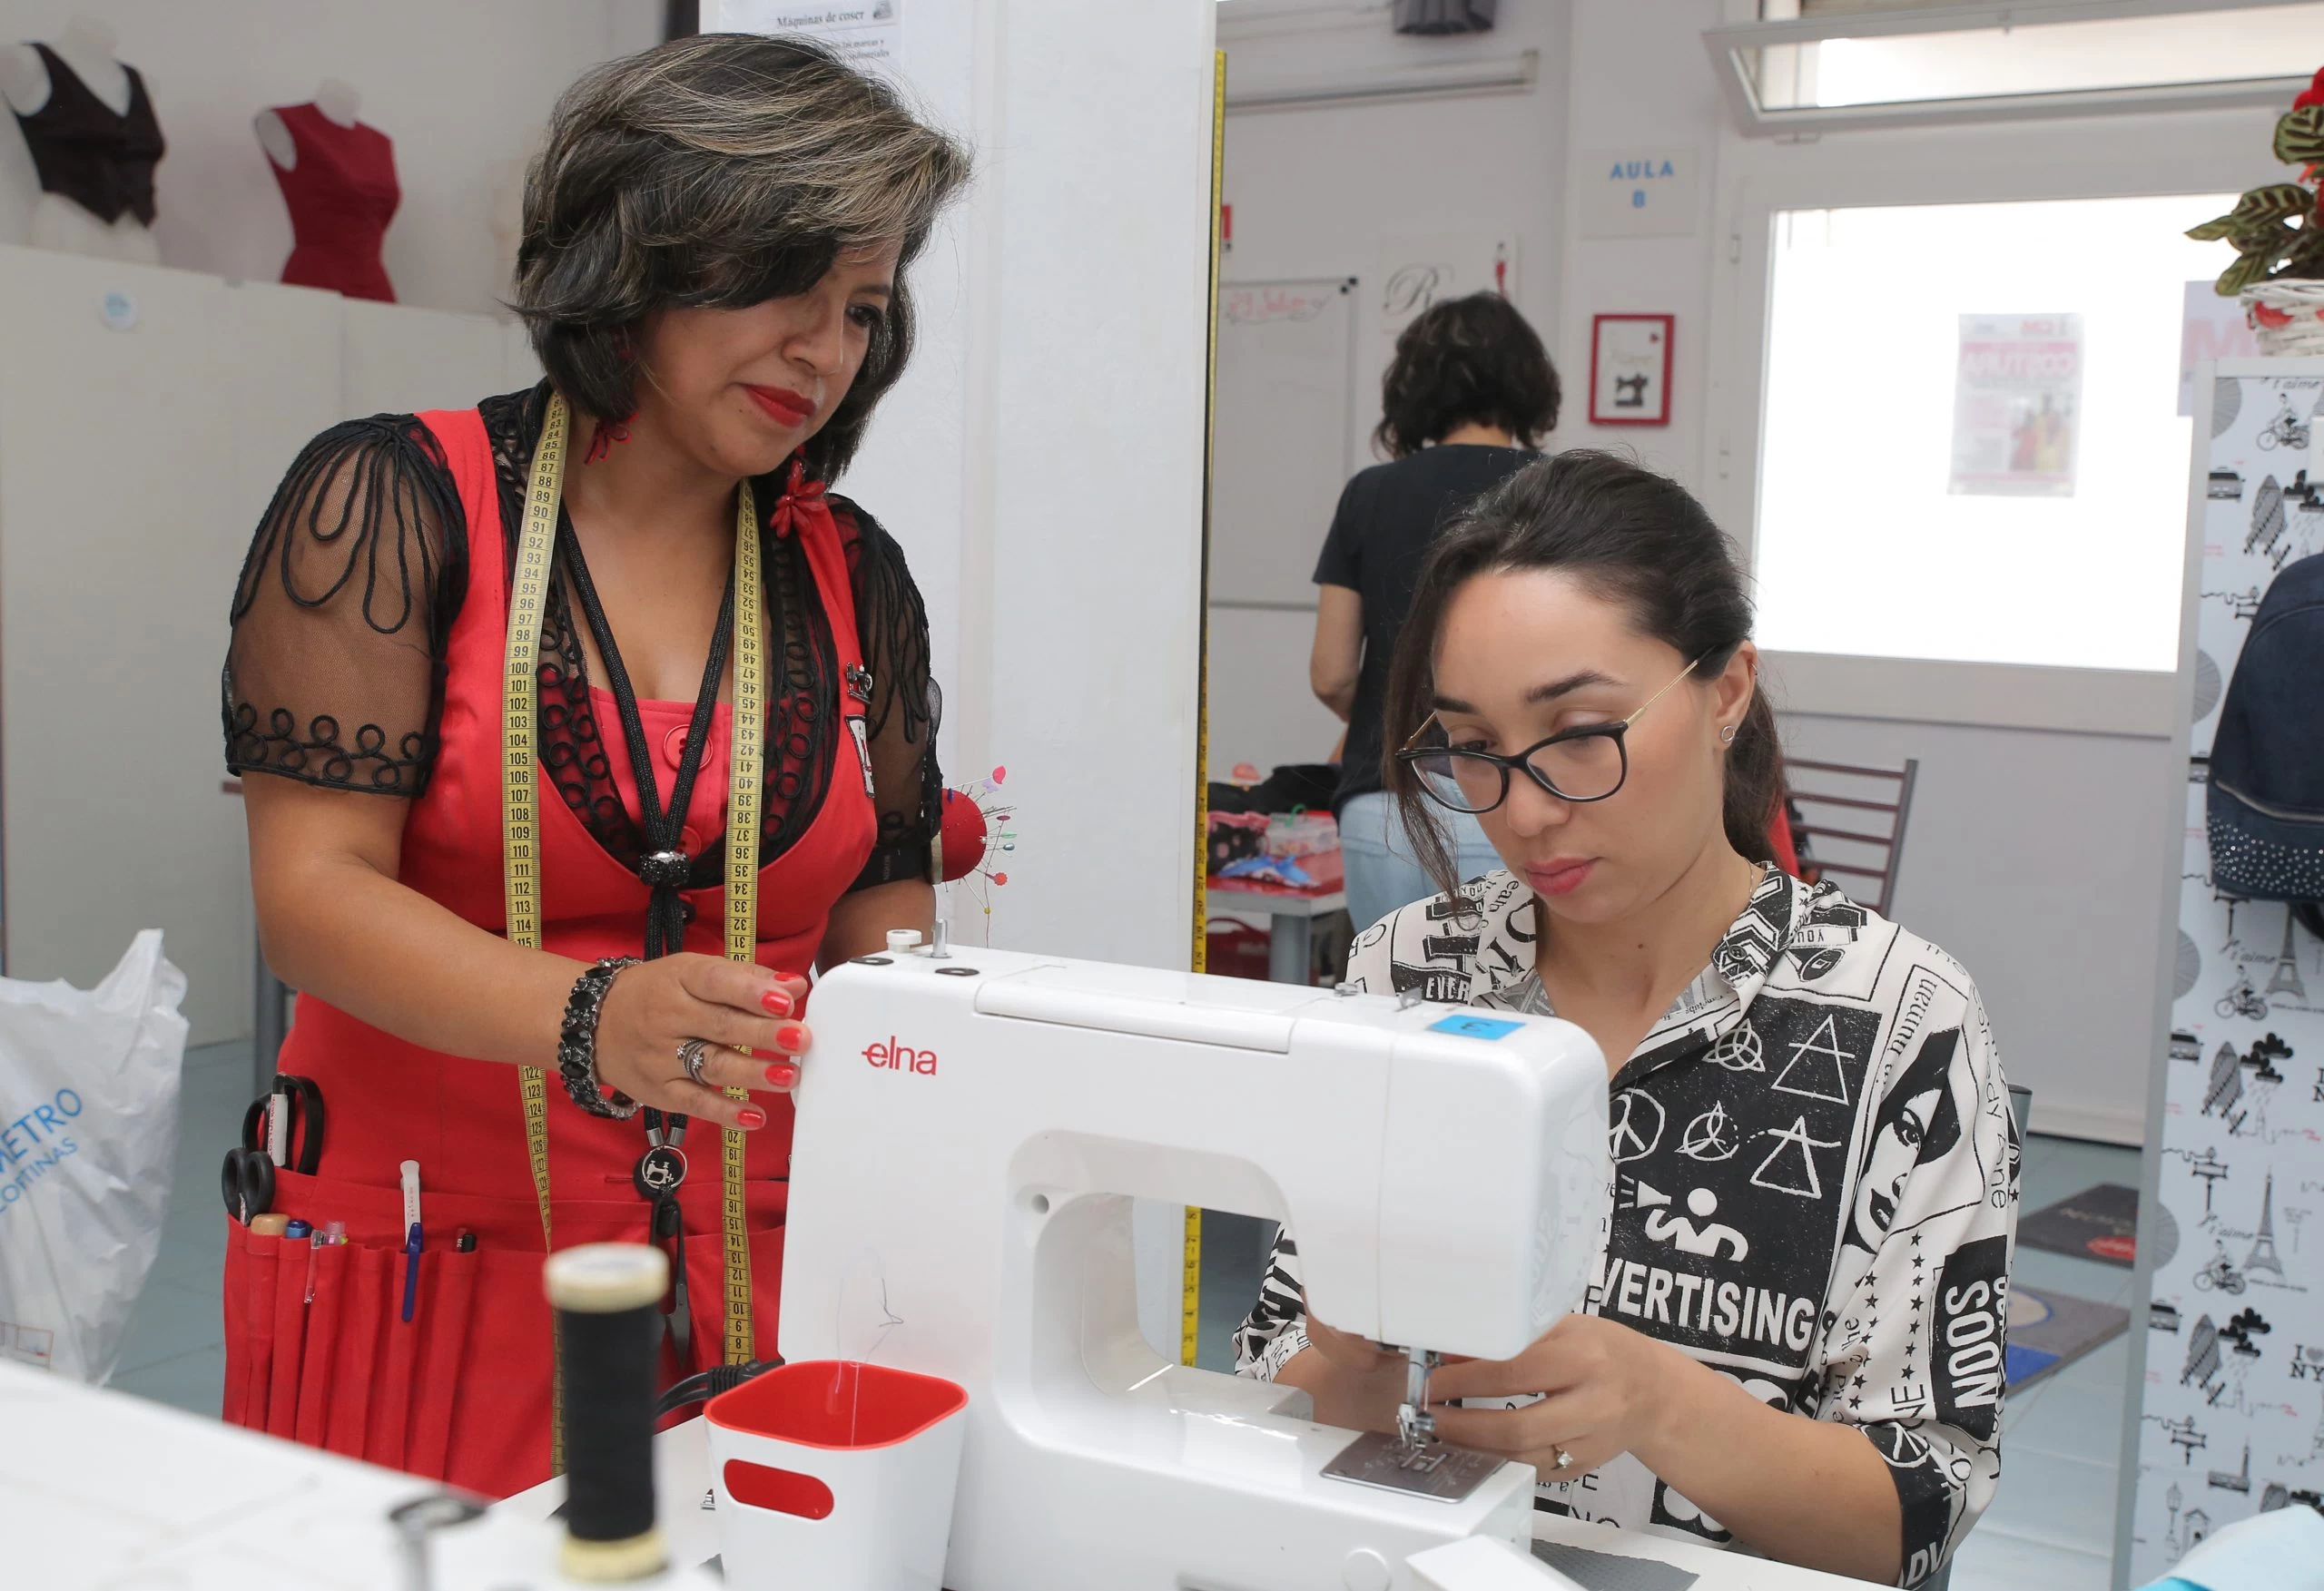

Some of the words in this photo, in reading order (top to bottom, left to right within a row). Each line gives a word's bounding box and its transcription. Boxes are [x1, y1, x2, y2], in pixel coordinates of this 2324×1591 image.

[1610, 161, 1674, 180] AULA
[1631, 190, 1646, 209] B
[550, 419, 561, 428] 83
[547, 430, 559, 439] 84
[545, 440, 557, 449] 85
[543, 452, 556, 460] 86
[541, 464, 554, 472] 87
[538, 476, 552, 486] 88
[536, 490, 550, 502] 89
[533, 506, 548, 517] 90
[532, 522, 545, 533] 91
[529, 536, 544, 548] 92
[743, 541, 753, 554] 56
[527, 553, 541, 564] 93
[743, 555, 754, 567] 55
[524, 568, 538, 578] 94
[743, 569, 754, 581] 54
[522, 584, 537, 594] 95
[743, 583, 754, 594] 53
[519, 598, 534, 609] 96
[743, 598, 754, 609] 52
[518, 614, 532, 624] 97
[743, 612, 753, 623] 51
[516, 630, 530, 641] 98
[743, 625, 755, 637] 50
[514, 646, 528, 656] 99
[743, 639, 756, 651] 49
[743, 653, 756, 665] 48
[511, 663, 528, 673] 100
[743, 668, 756, 679] 47
[511, 680, 527, 691] 101
[743, 683, 756, 694] 46
[509, 698, 527, 710] 102
[742, 699, 756, 710] 45
[509, 716, 527, 728] 103
[741, 714, 755, 725] 44
[509, 734, 527, 746] 104
[741, 730, 754, 741] 43
[740, 745, 754, 756] 42
[509, 752, 527, 764] 105
[740, 761, 753, 772] 41
[510, 771, 528, 782] 106
[739, 778, 753, 790] 40
[510, 790, 528, 801] 107
[738, 795, 752, 806] 39
[511, 808, 529, 820] 108
[737, 812, 751, 824] 38
[511, 827, 529, 839] 109
[736, 830, 750, 841] 37
[513, 845, 528, 857] 110
[735, 848, 749, 859] 36
[515, 864, 528, 876] 111
[734, 865, 749, 878] 35
[514, 882, 529, 894] 112
[734, 883, 748, 895] 34
[515, 900, 530, 912] 113
[734, 900, 747, 913] 33
[516, 919, 531, 931] 114
[734, 918, 747, 931] 32
[734, 937, 745, 948] 31
[862, 1035, 936, 1075] elna
[525, 1067, 539, 1078] 122
[527, 1085, 541, 1097] 123
[529, 1103, 542, 1115] 124
[531, 1122, 542, 1134] 125
[727, 1130, 738, 1143] 20
[533, 1140, 543, 1153] 126
[729, 1148, 738, 1161] 19
[728, 1165, 737, 1178] 18
[729, 1183, 737, 1196] 17
[729, 1201, 737, 1213] 16
[729, 1218, 738, 1230] 15
[731, 1235, 741, 1247] 14
[732, 1252, 741, 1263] 13
[733, 1269, 742, 1281] 12
[734, 1286, 742, 1298] 11
[734, 1303, 743, 1315] 10
[735, 1338, 742, 1350] 8
[1945, 1280, 2000, 1409] SOON
